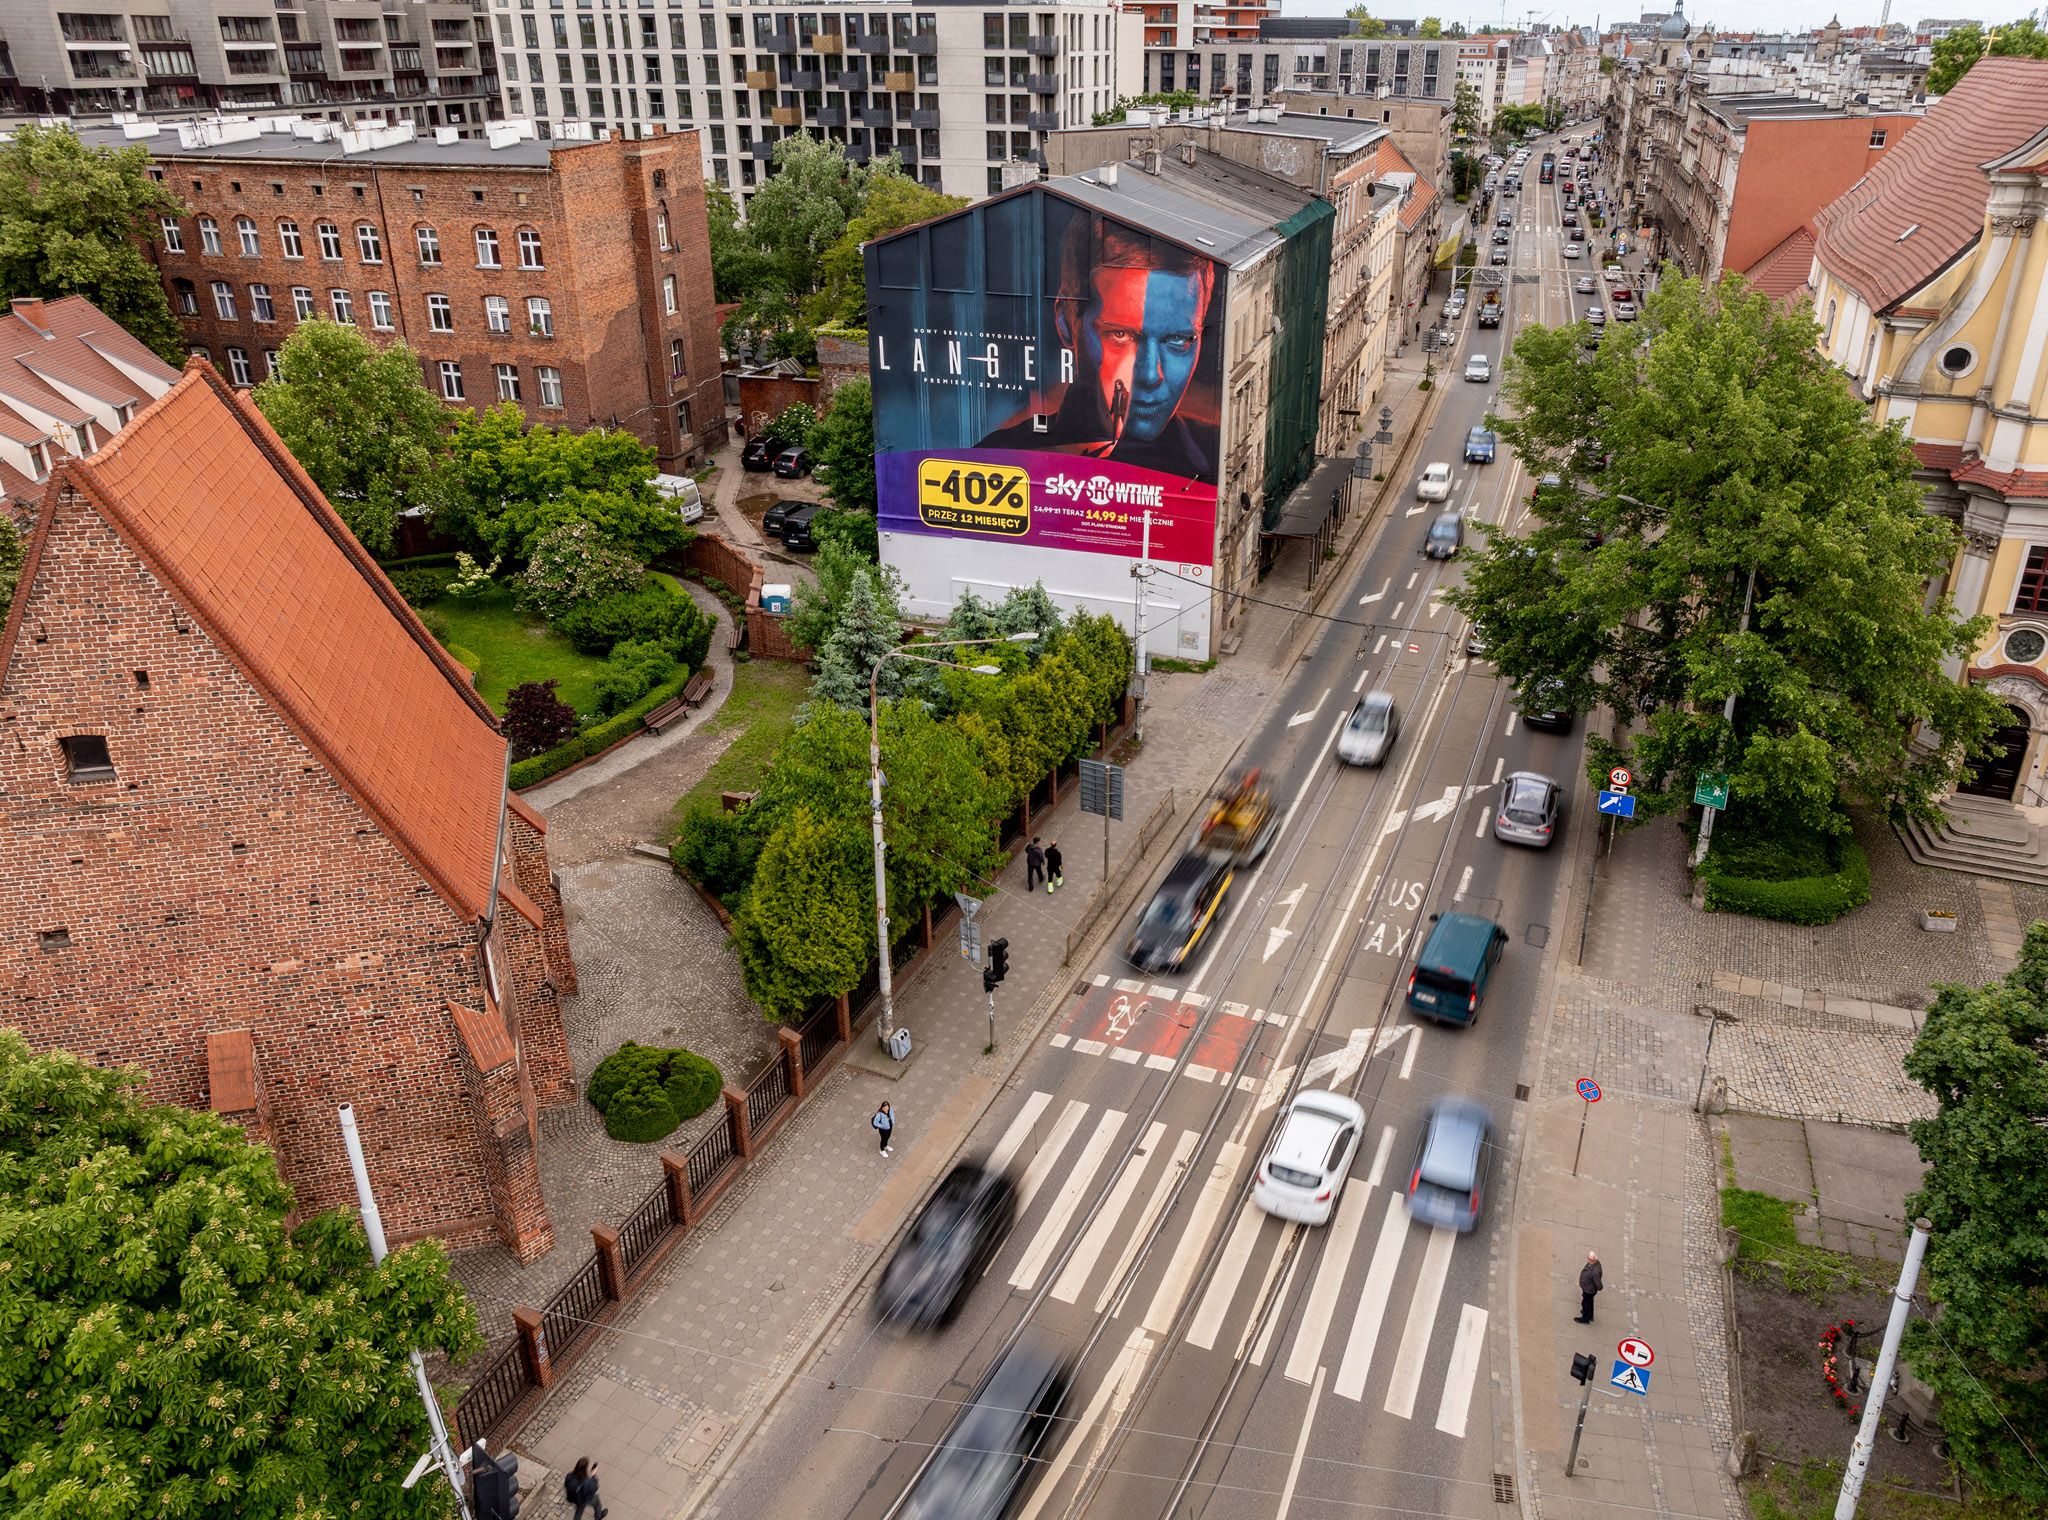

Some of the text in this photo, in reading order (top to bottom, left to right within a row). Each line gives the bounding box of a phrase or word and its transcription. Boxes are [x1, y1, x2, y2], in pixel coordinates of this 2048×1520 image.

[979, 332, 1036, 341] ORYGINALNY
[878, 336, 1074, 384] LANGER
[923, 377, 973, 387] PREMIERA
[997, 383, 1023, 391] MAJA
[925, 469, 1024, 509] -40%
[928, 509, 1021, 529] PRZEZ 12 MIESIĘCY
[1062, 508, 1085, 517] TERAZ
[1085, 509, 1117, 522] 14,99
[1117, 512, 1129, 523] zł
[1612, 772, 1628, 782] 40
